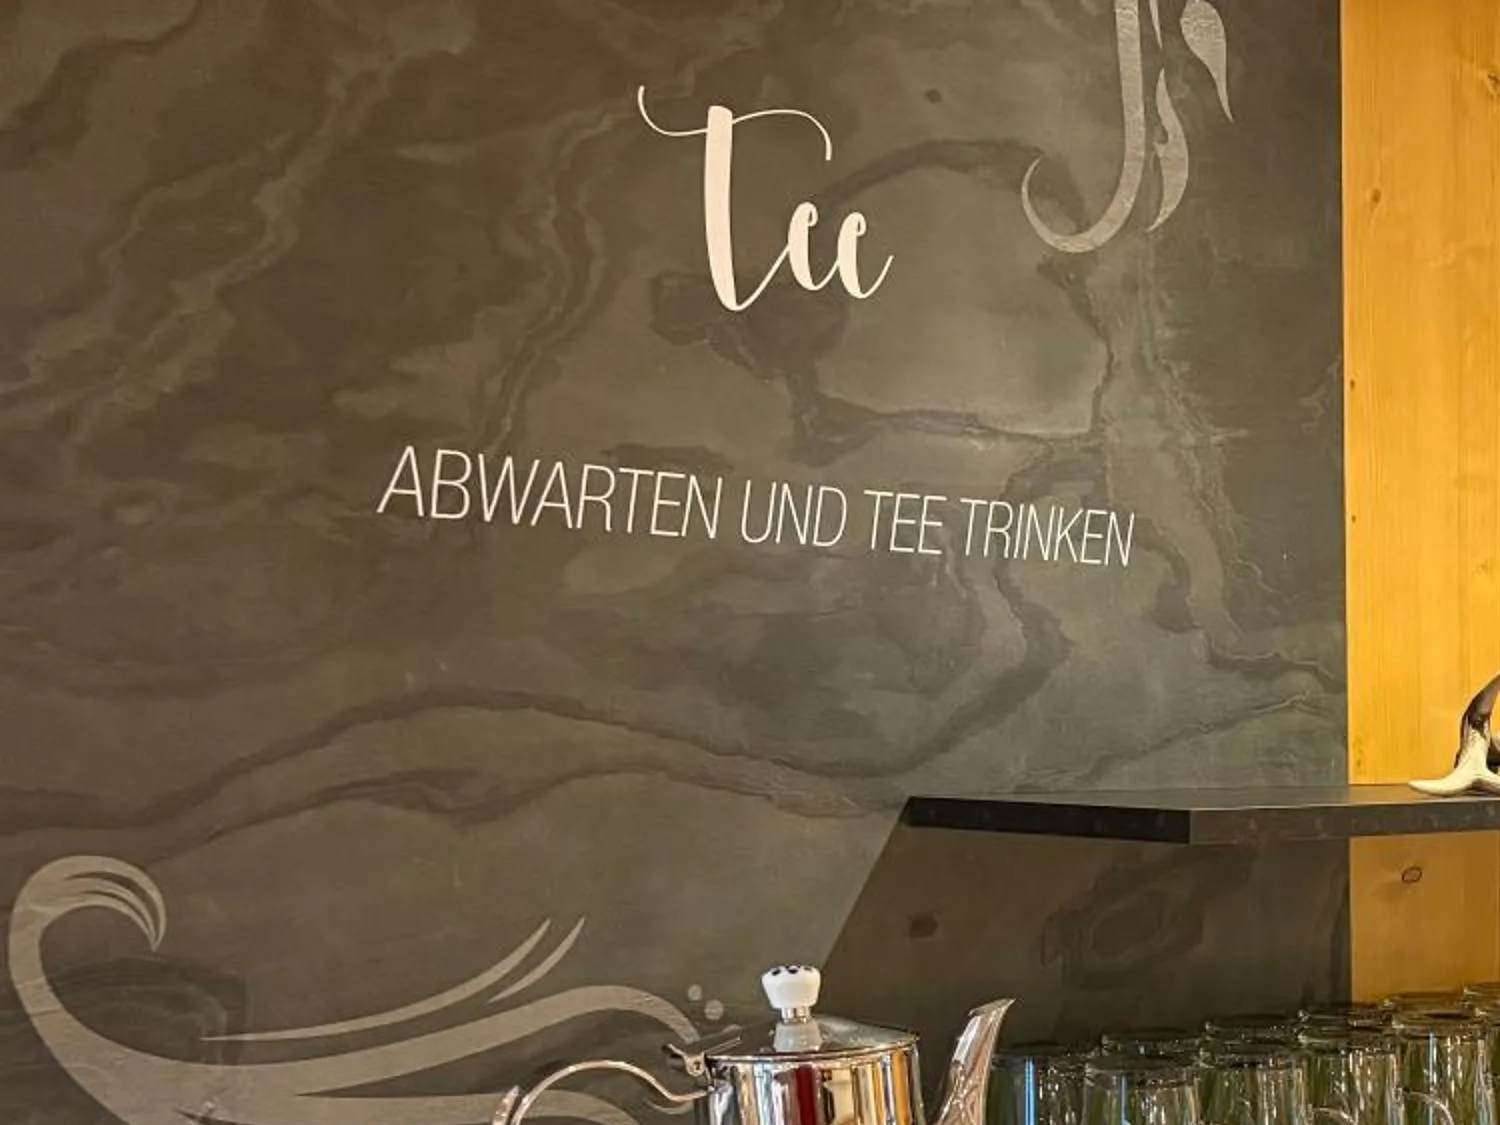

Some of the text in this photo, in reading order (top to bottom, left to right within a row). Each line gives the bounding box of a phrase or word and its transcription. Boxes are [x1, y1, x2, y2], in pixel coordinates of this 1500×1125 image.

[638, 85, 894, 311] Tee
[377, 445, 1136, 568] ABWARTEN UND TEE TRINKEN
